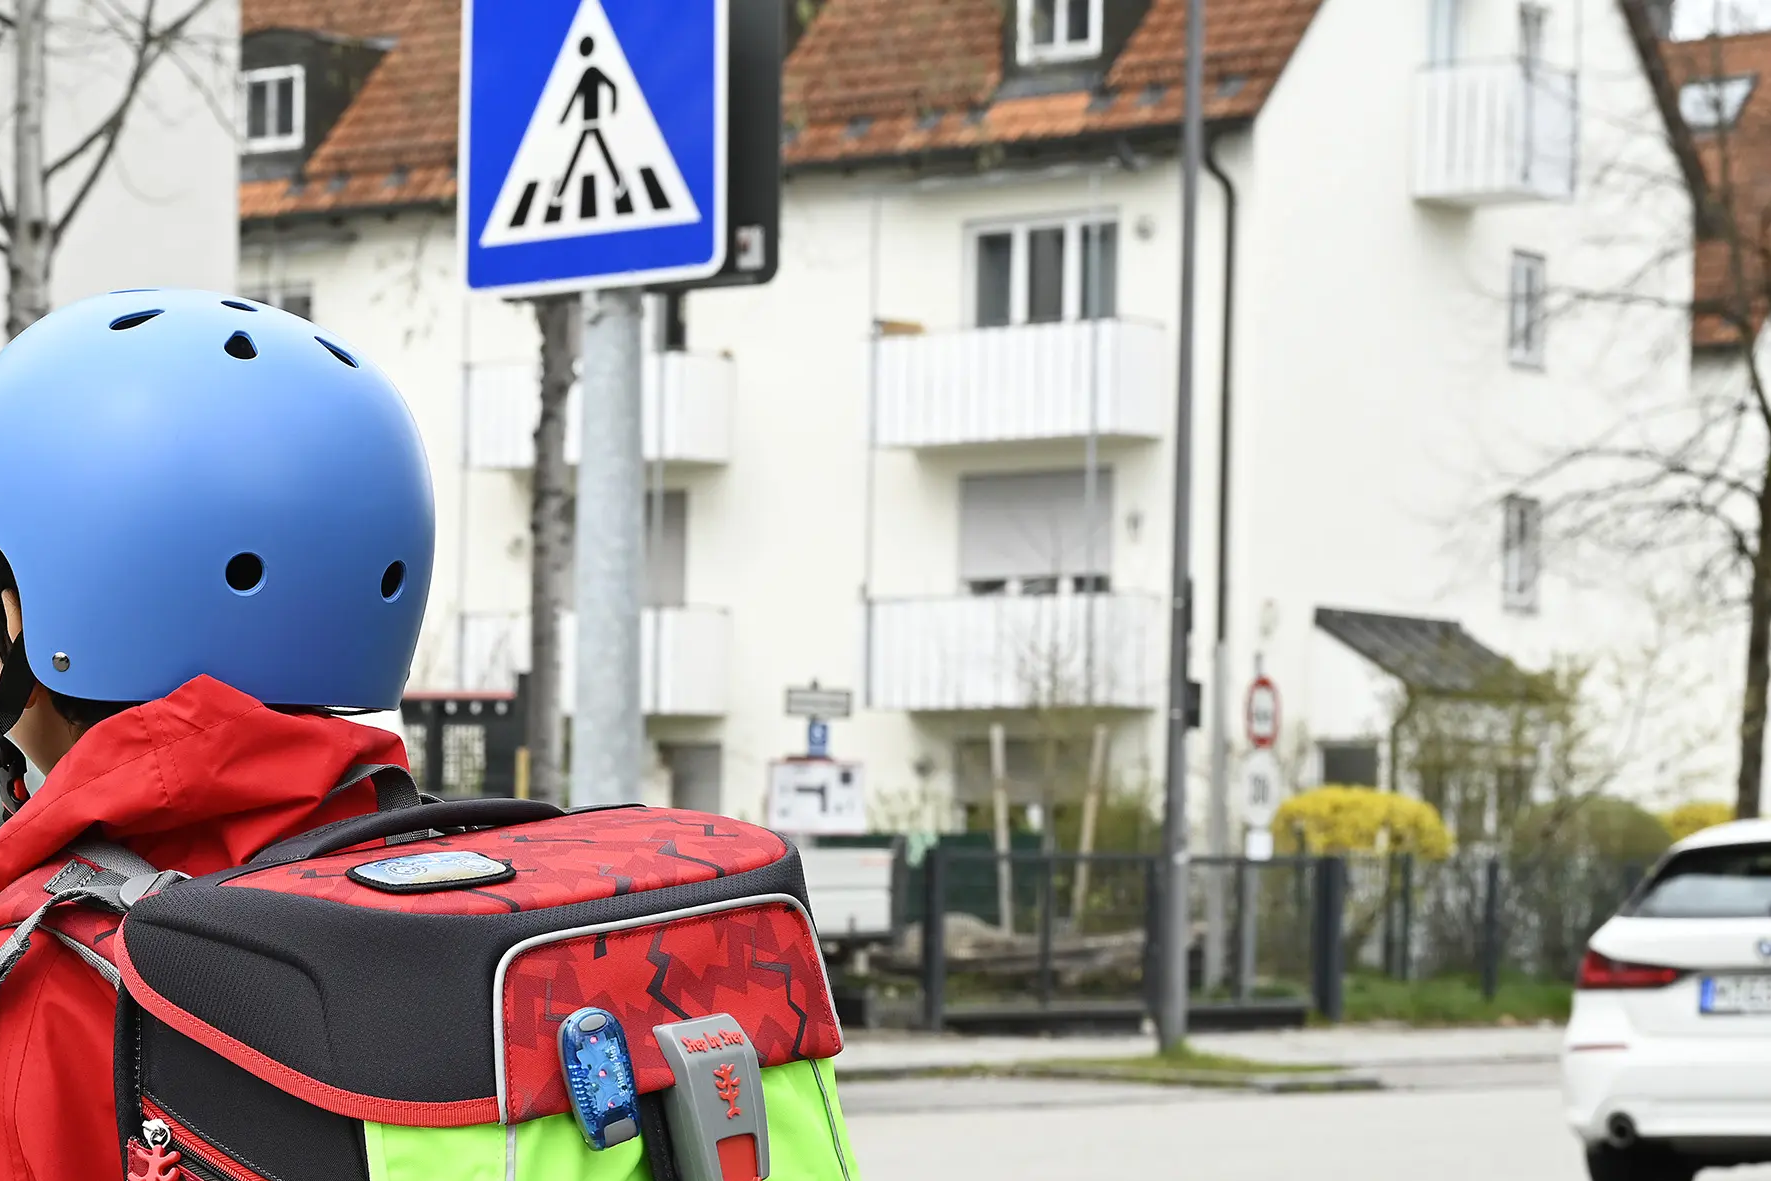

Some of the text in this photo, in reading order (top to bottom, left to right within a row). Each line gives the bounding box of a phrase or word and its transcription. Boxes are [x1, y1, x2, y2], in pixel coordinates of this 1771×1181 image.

[680, 1028, 744, 1053] Step by Step
